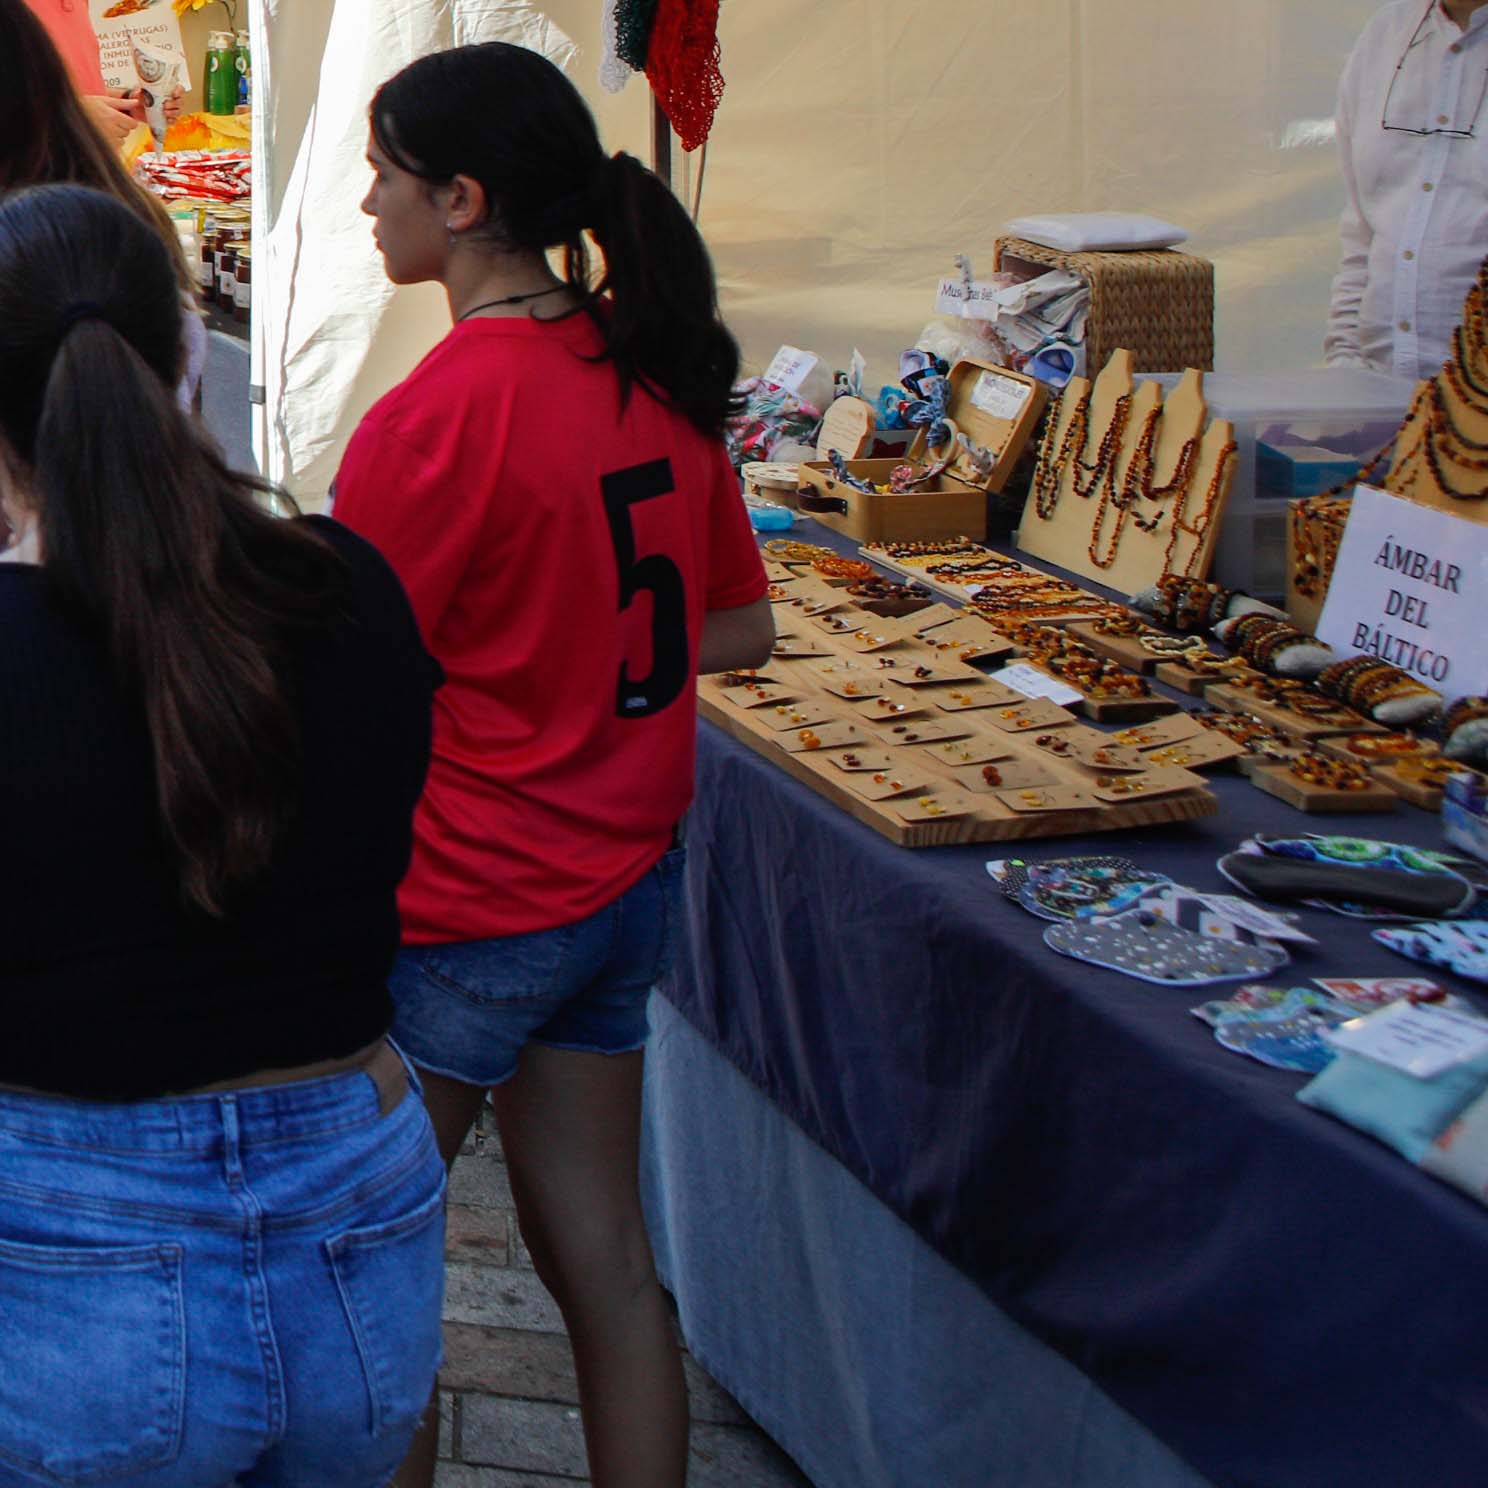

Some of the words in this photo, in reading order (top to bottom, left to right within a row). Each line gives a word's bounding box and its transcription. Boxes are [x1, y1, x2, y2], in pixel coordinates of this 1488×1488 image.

[600, 456, 690, 720] 5
[1373, 535, 1462, 594] ÁMBAR
[1384, 589, 1430, 629] DEL
[1352, 622, 1450, 682] BÁLTICO
